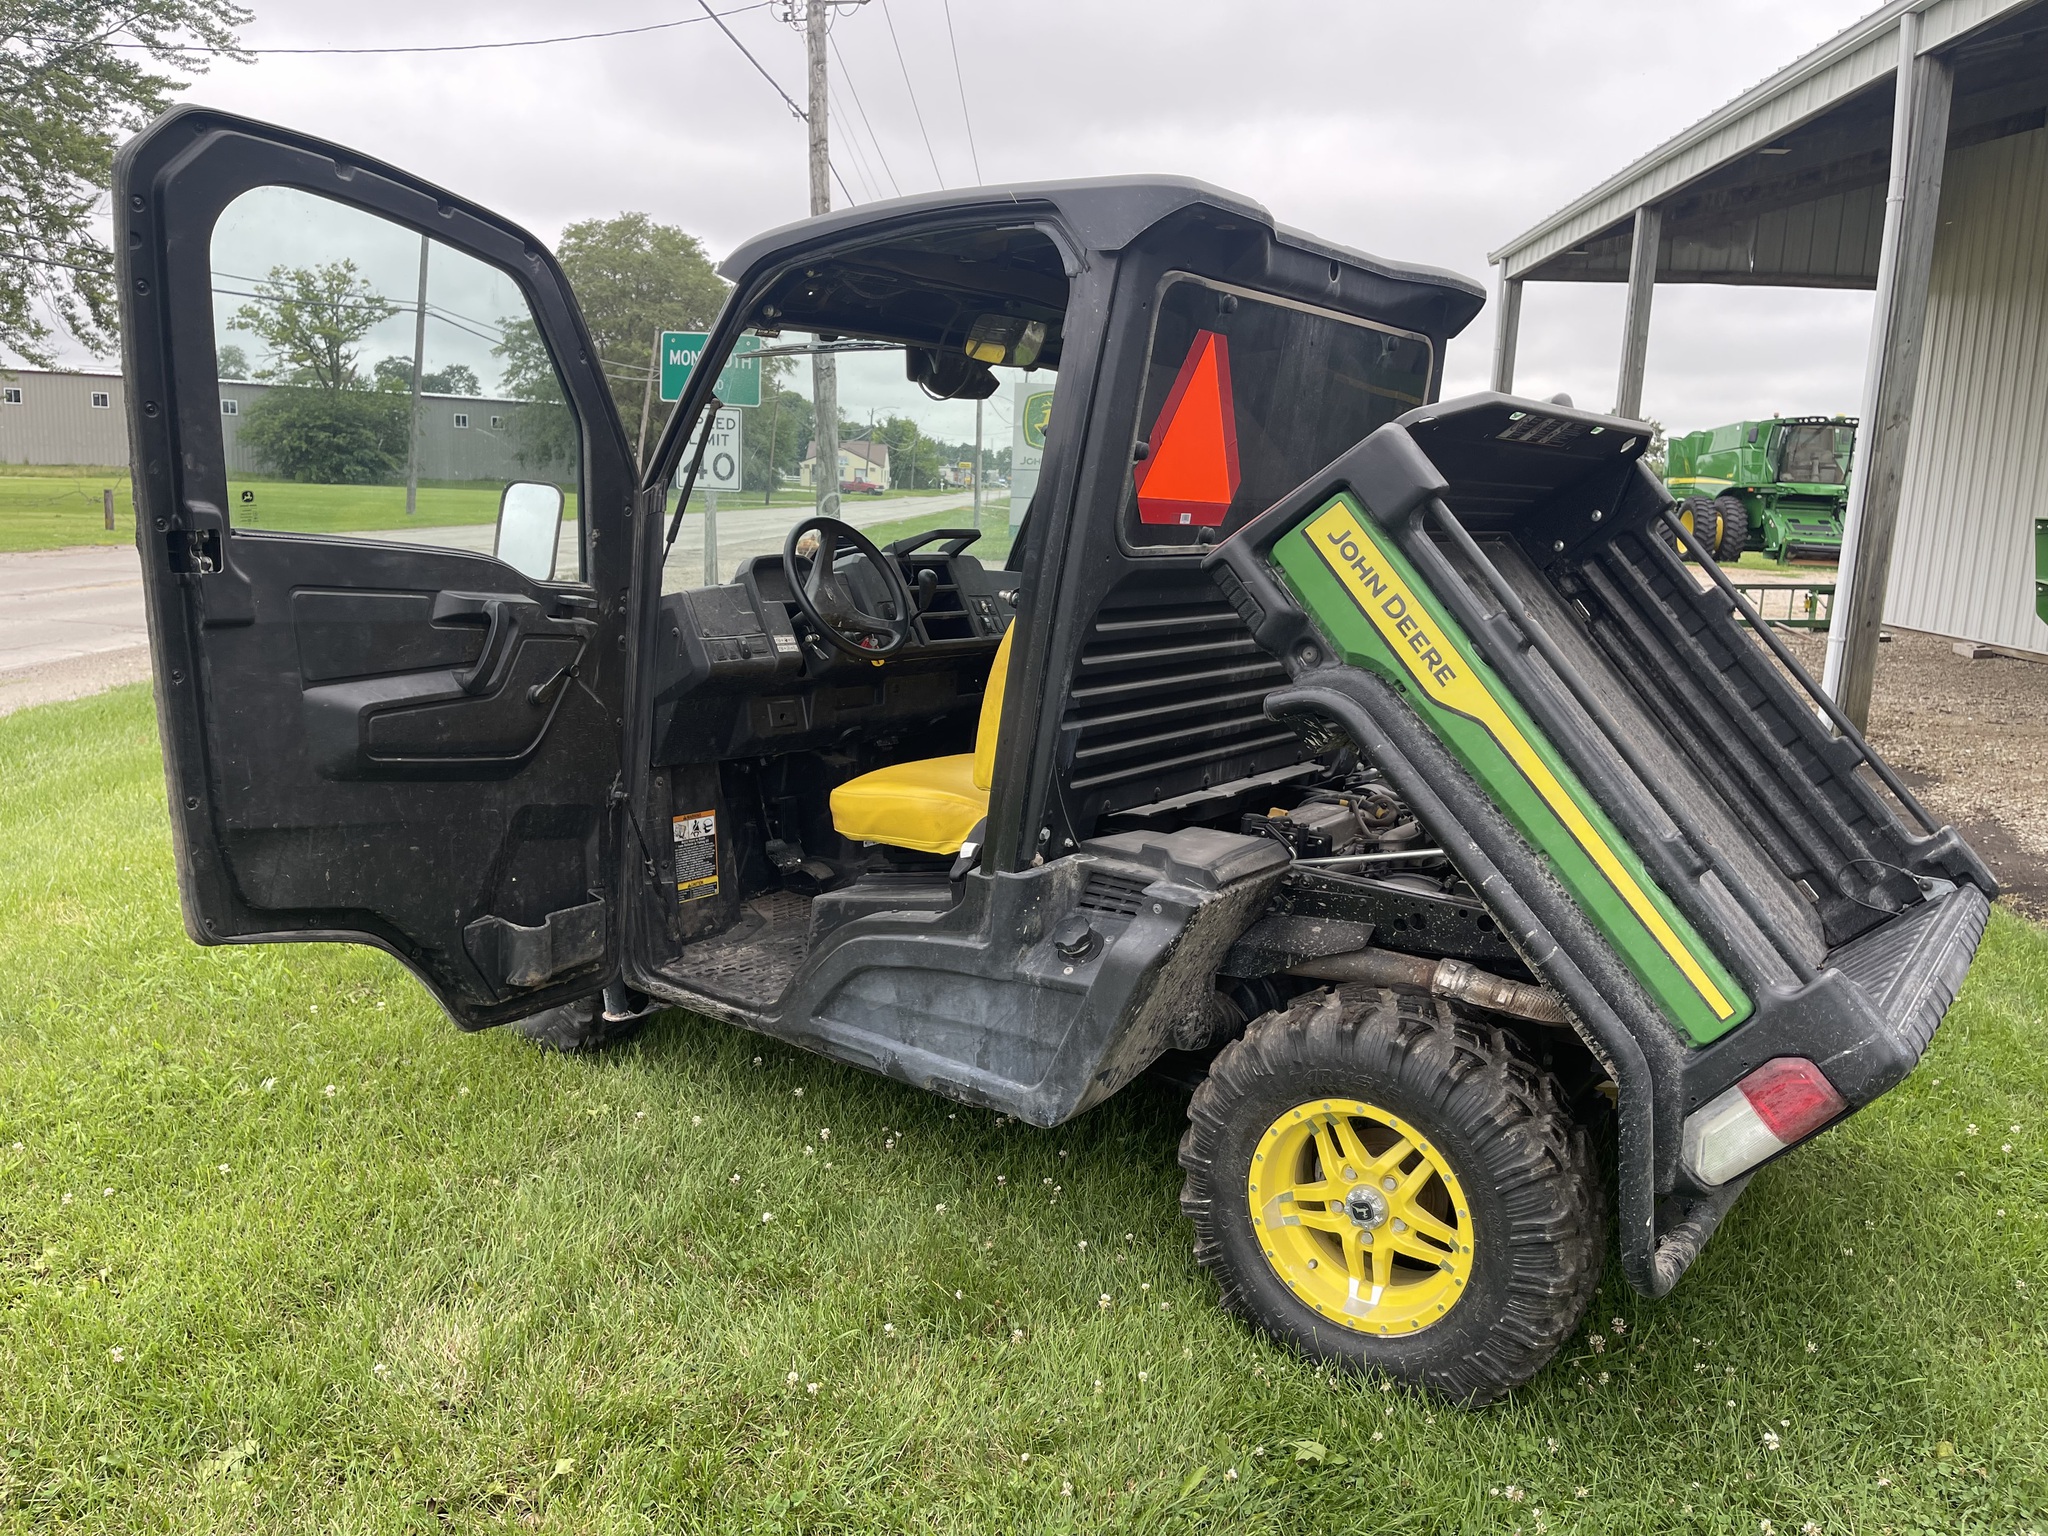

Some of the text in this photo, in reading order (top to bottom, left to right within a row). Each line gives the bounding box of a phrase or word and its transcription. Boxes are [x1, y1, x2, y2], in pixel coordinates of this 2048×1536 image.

[669, 349, 752, 370] MONUTH
[683, 451, 735, 481] 40
[1326, 529, 1457, 688] JOHN DEERE
